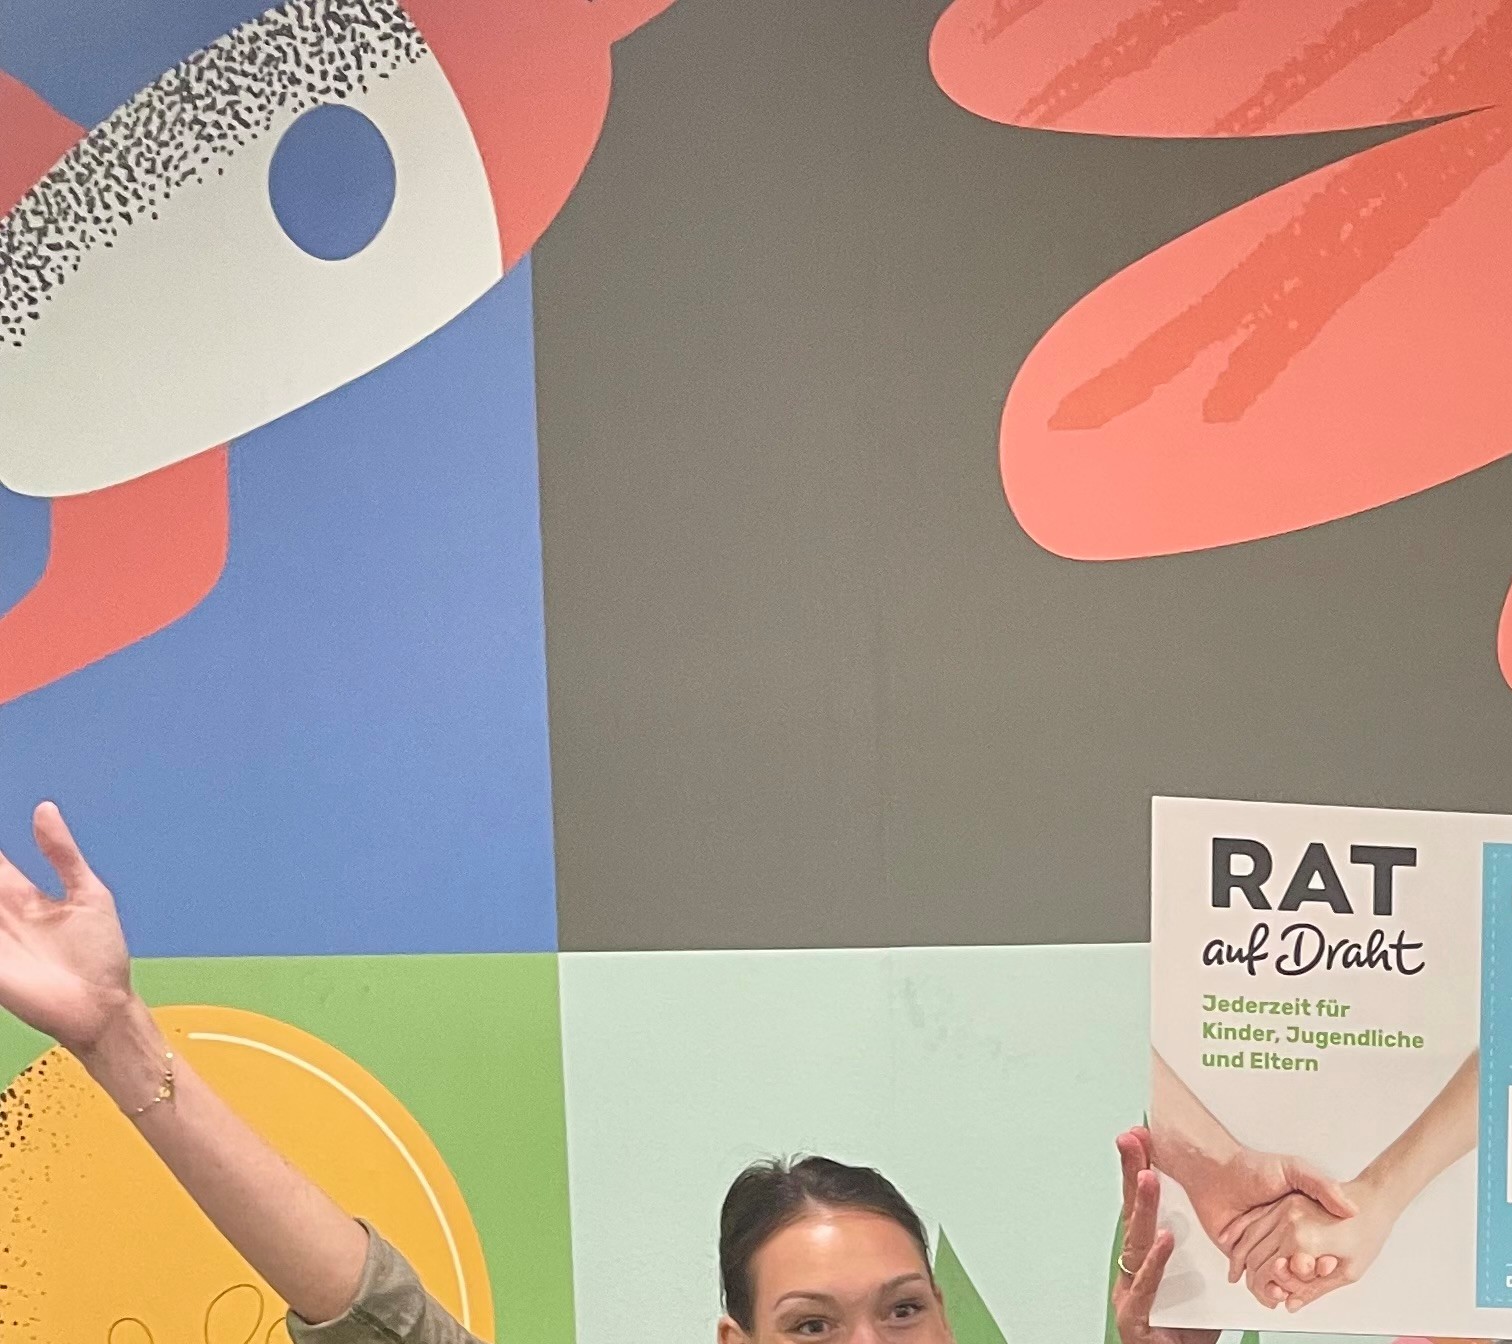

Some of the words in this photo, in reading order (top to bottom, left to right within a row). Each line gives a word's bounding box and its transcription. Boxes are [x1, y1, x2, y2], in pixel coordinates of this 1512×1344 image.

[1210, 836, 1418, 917] RAT
[1202, 922, 1270, 976] auf
[1274, 922, 1426, 976] Draht
[1202, 994, 1311, 1016] Jederzeit
[1316, 998, 1351, 1018] für
[1202, 1021, 1280, 1044] Kinder,
[1286, 1025, 1425, 1050] Jugendliche
[1202, 1051, 1244, 1068] und
[1249, 1051, 1319, 1072] Eltern
